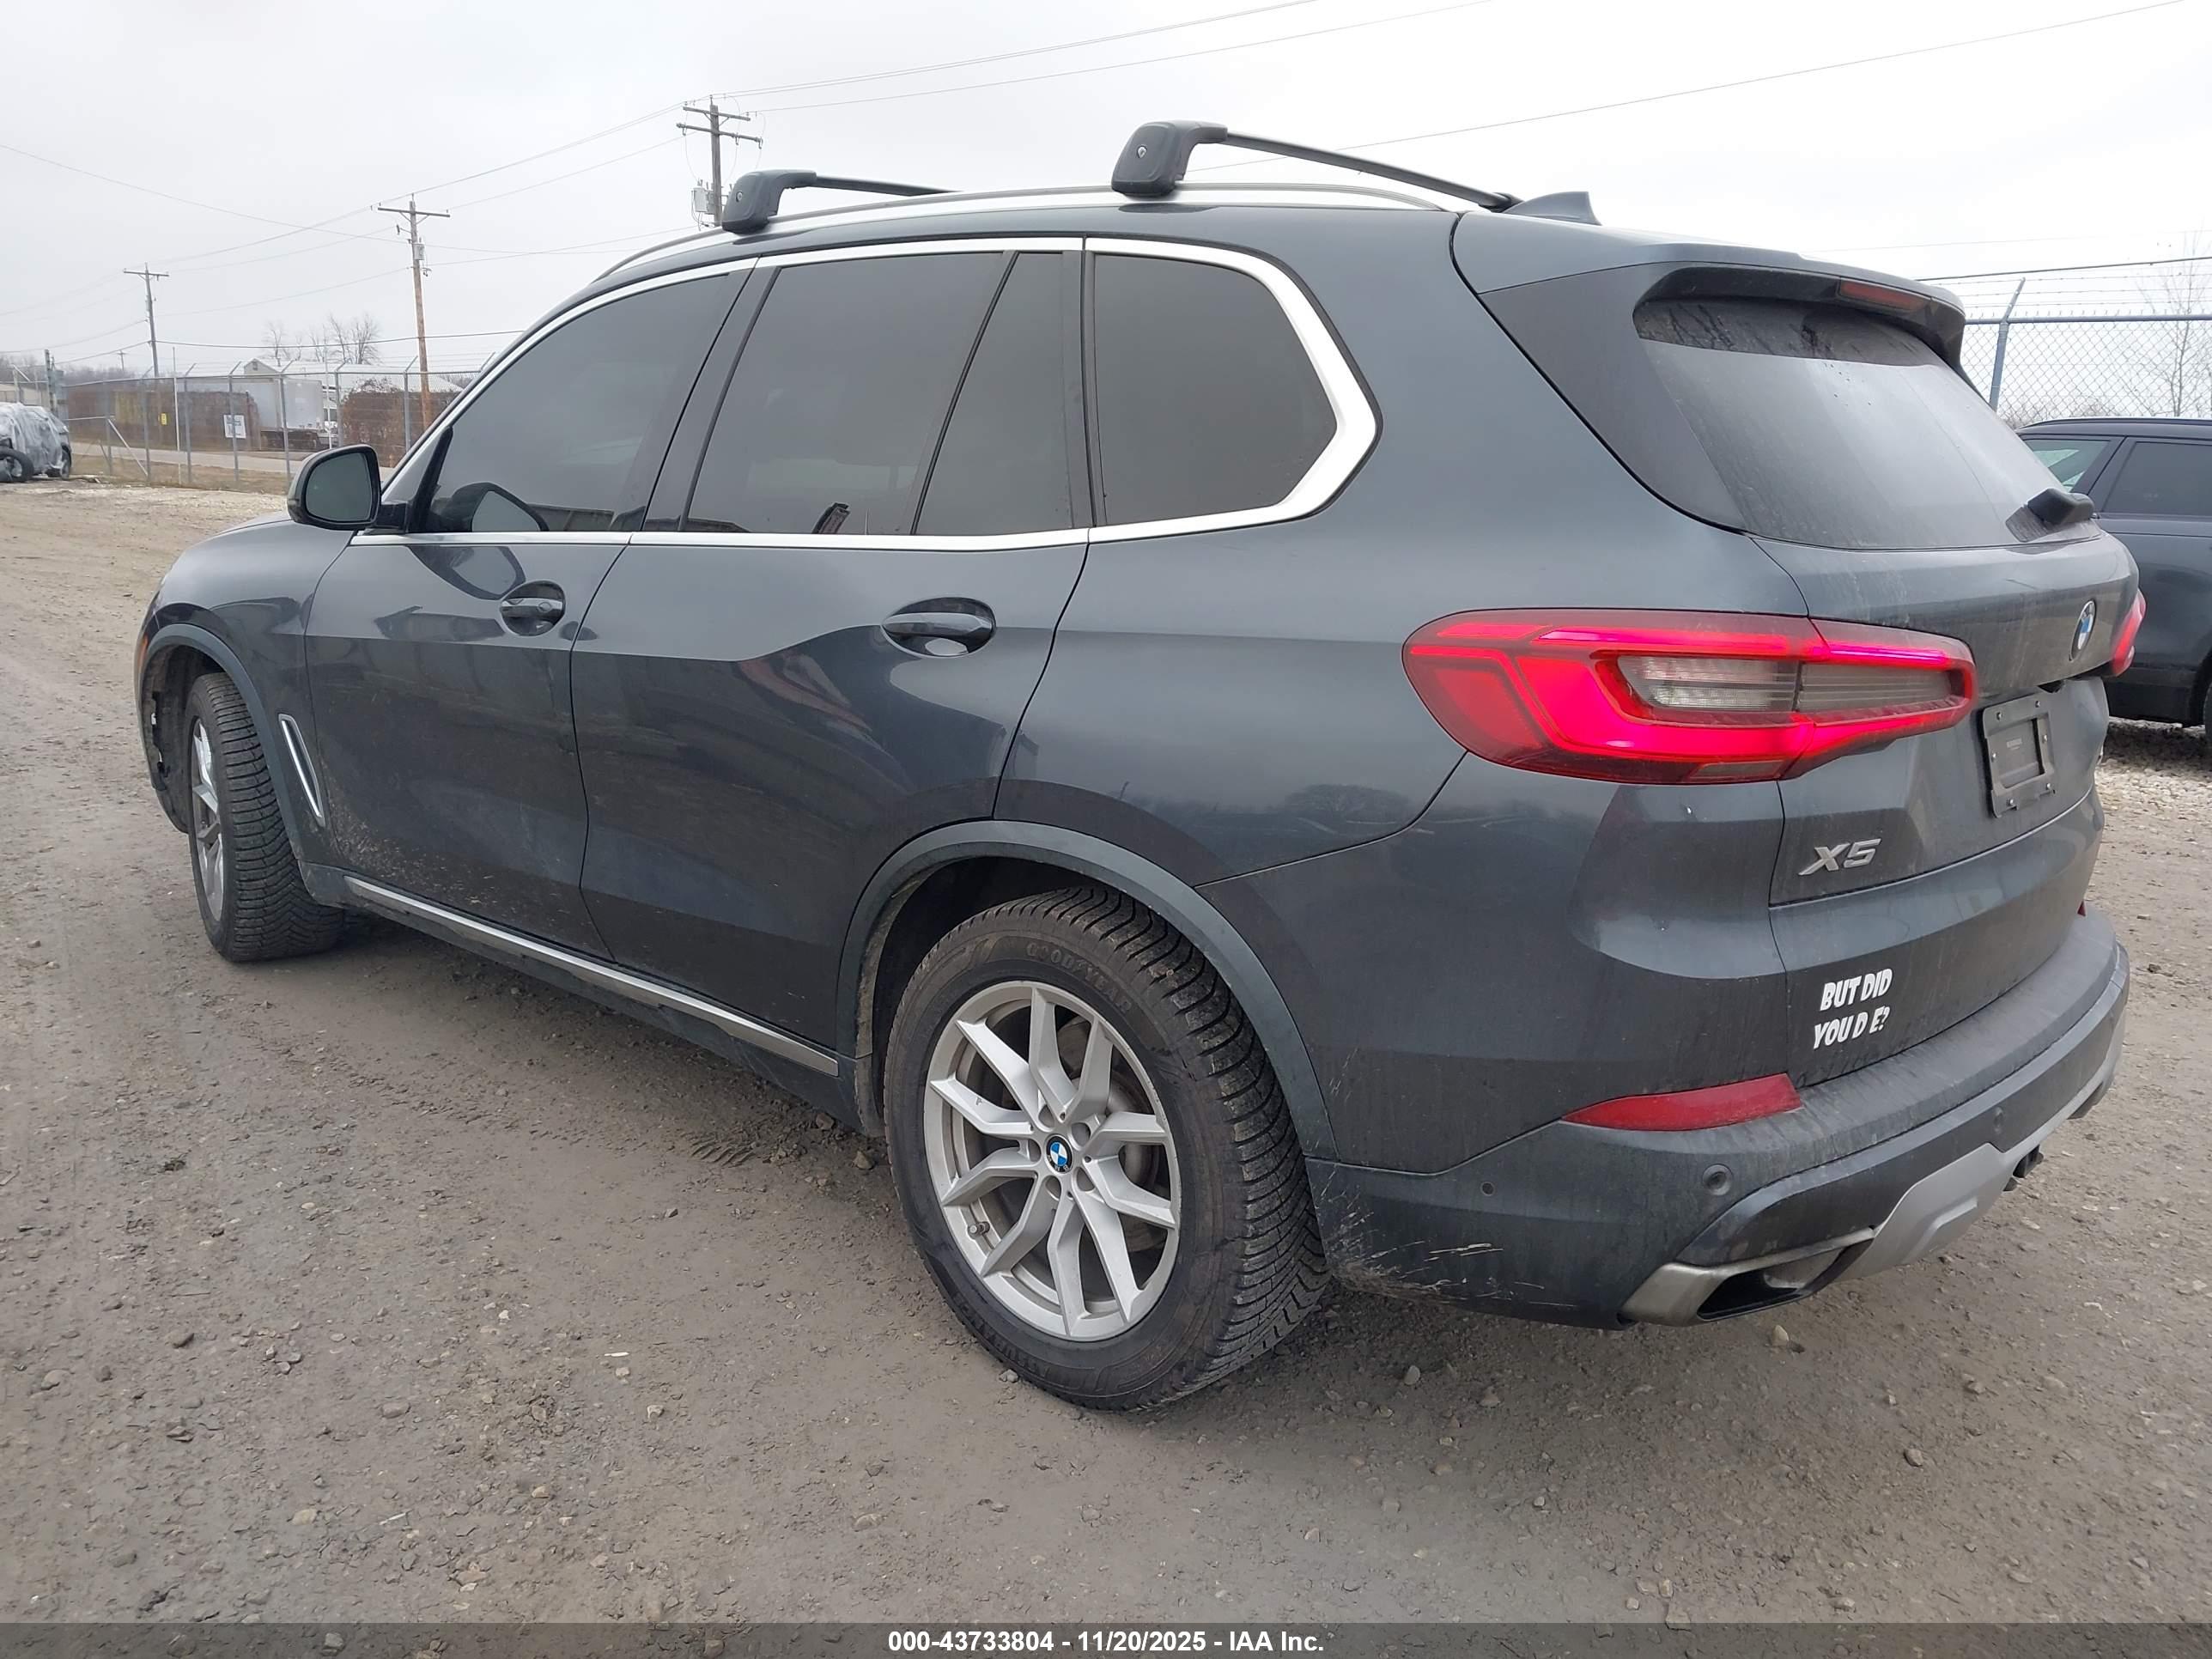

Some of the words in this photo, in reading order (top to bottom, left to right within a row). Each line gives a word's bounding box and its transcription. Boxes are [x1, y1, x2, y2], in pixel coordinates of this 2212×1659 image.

[1798, 838, 1881, 876] X5
[1820, 975, 1863, 1012] BUT
[1860, 968, 1893, 1002] DID
[1813, 1014, 1855, 1050] YOU
